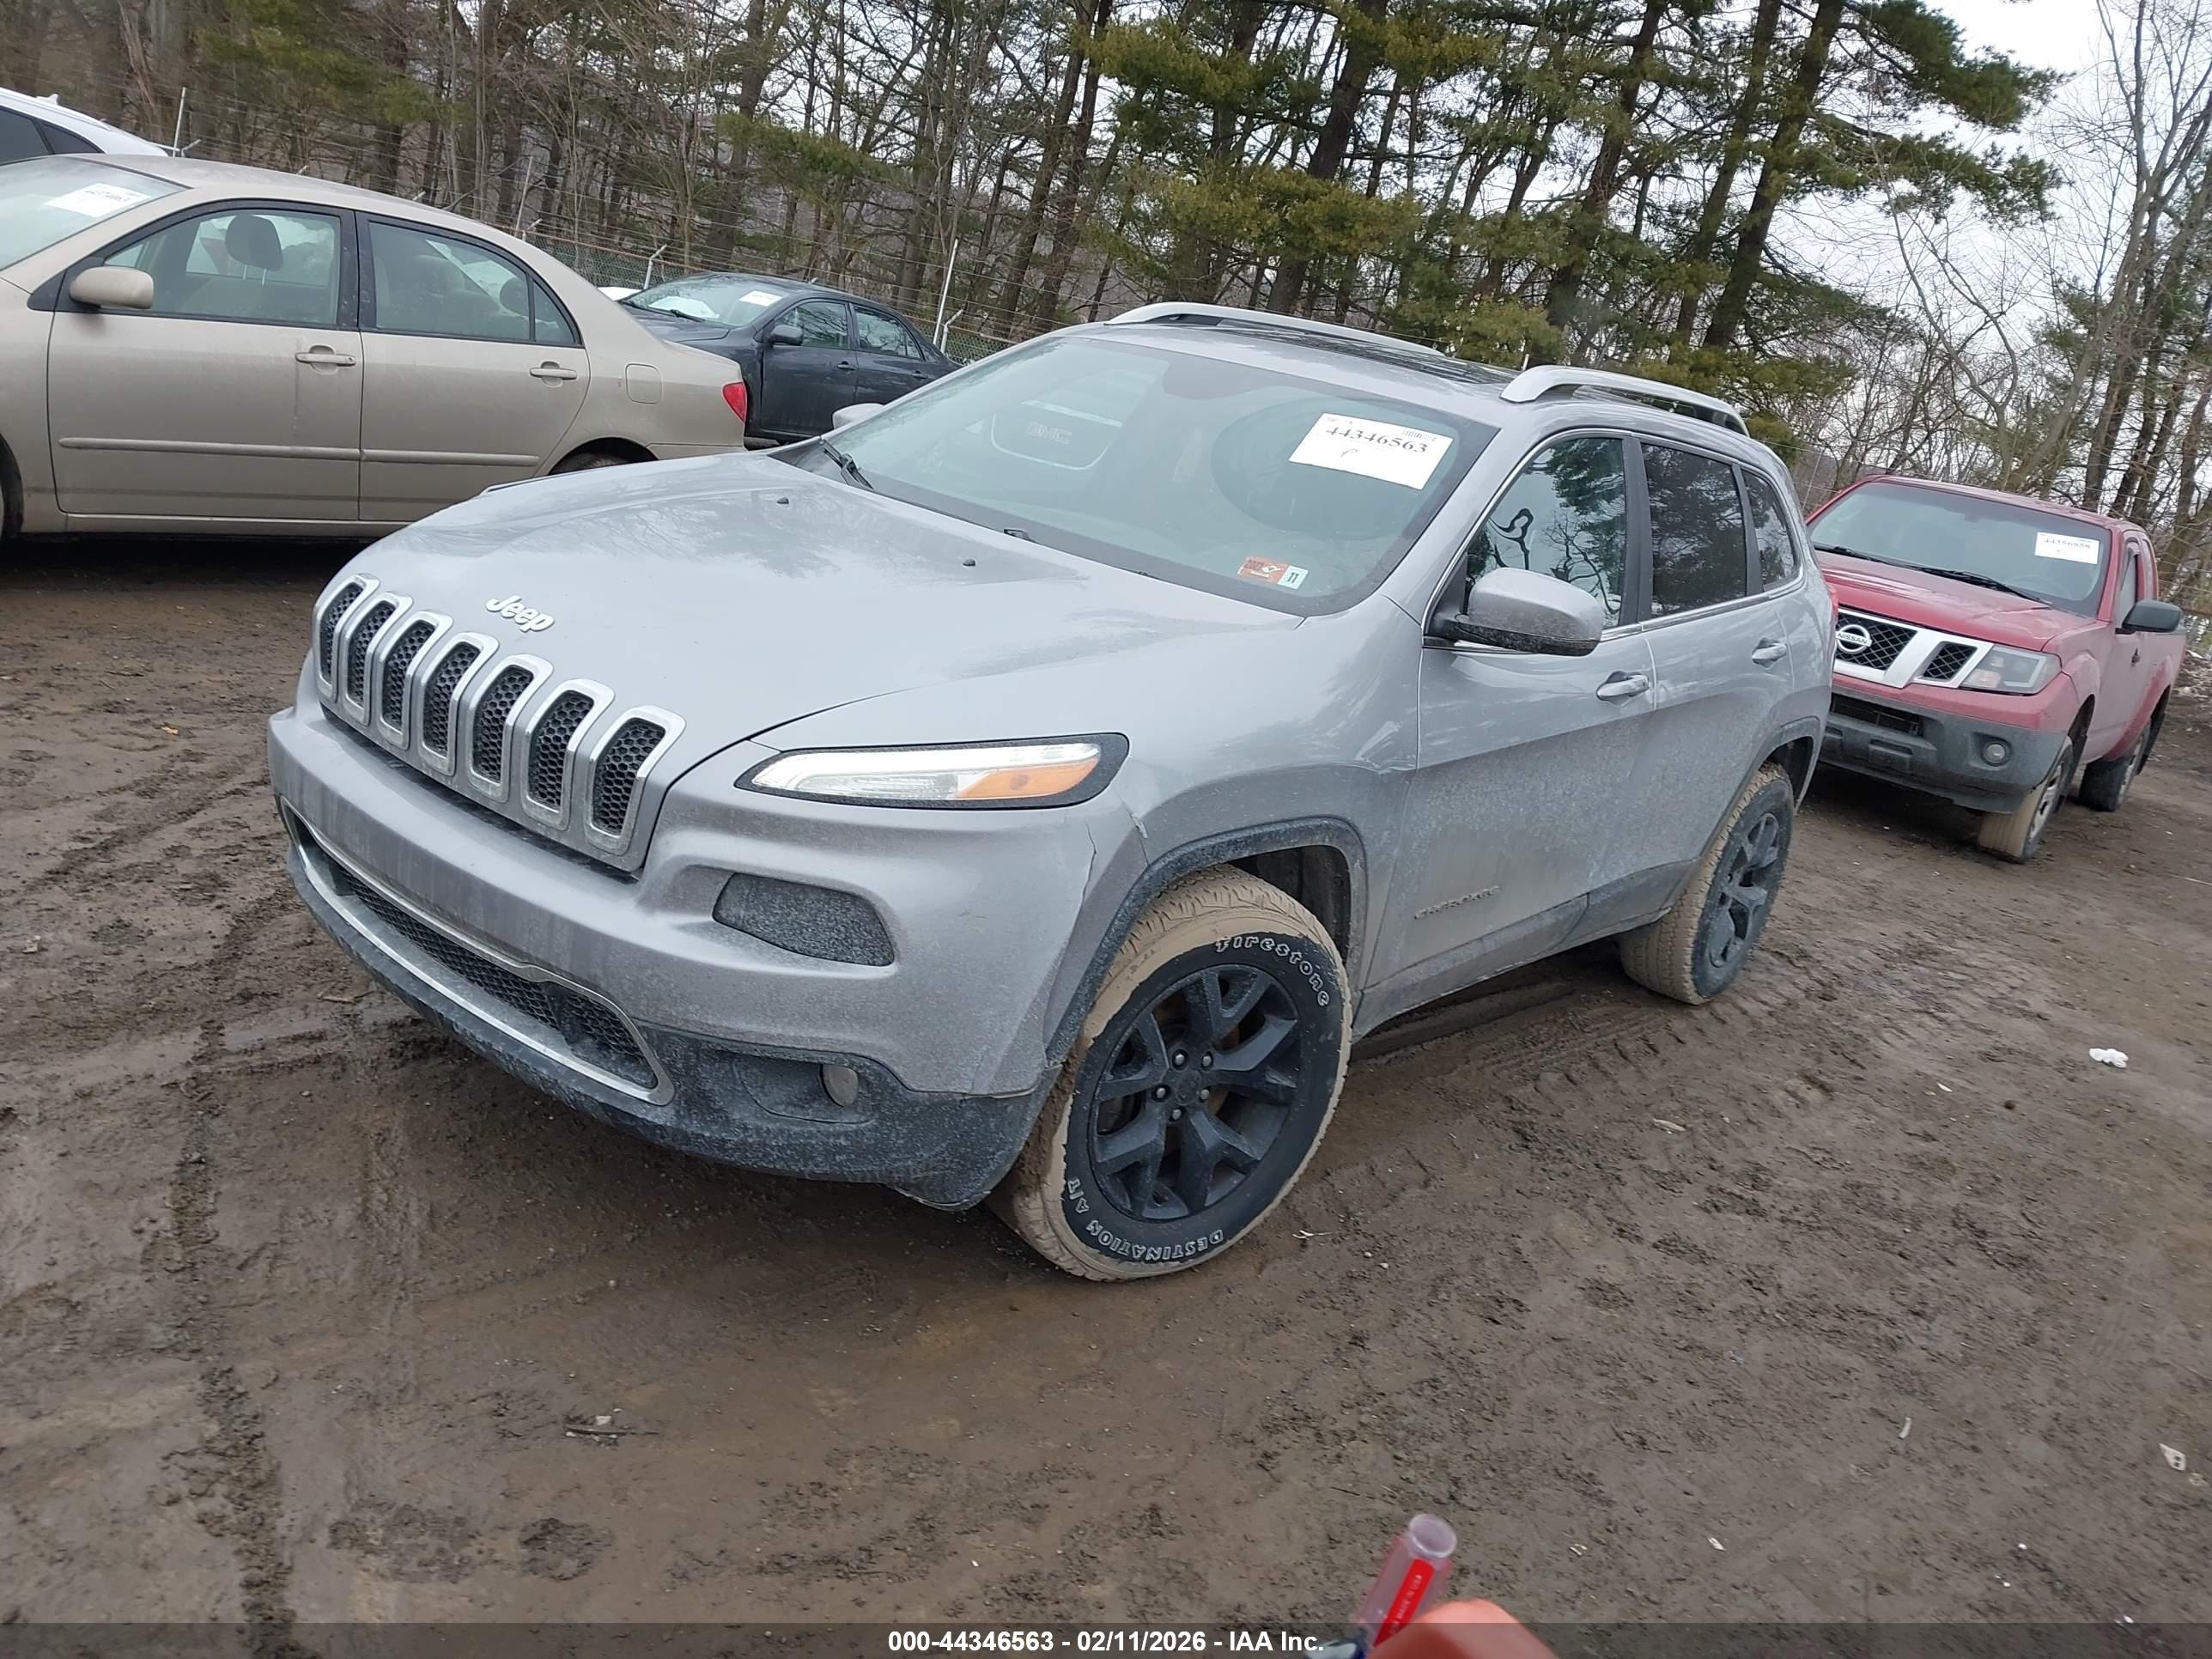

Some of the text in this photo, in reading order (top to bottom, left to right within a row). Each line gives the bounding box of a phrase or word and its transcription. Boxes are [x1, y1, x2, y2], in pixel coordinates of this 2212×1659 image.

[1325, 426, 1428, 453] 44346563
[484, 594, 555, 633] Jeep
[1838, 632, 1869, 645] NISSAN
[1066, 1177, 1224, 1261] DESTINATION A/T
